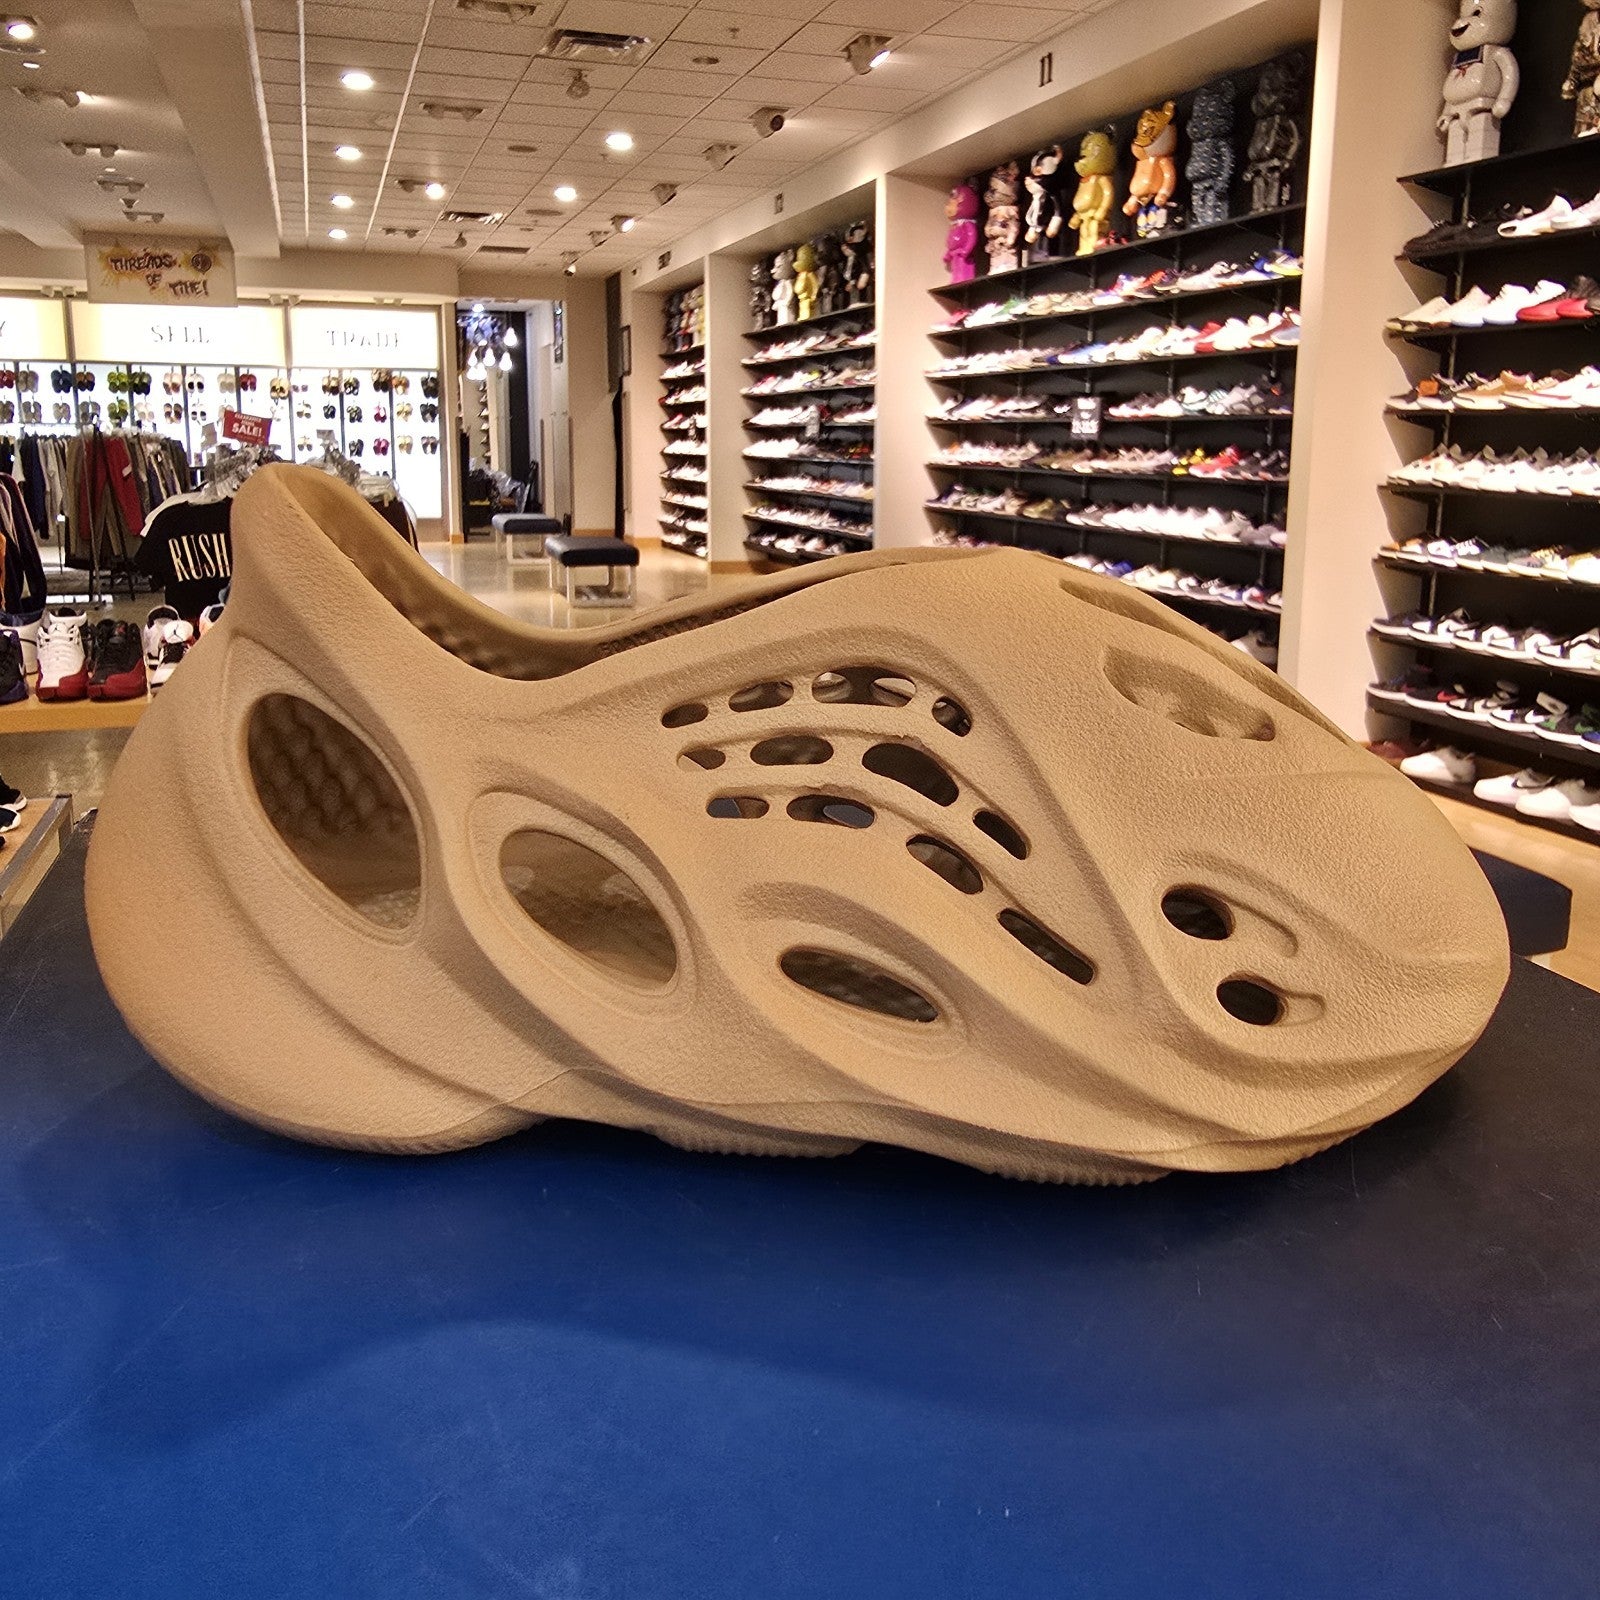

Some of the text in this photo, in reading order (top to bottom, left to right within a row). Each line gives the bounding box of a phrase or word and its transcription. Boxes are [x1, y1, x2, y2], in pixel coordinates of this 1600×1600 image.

[151, 325, 210, 343] SELL
[326, 330, 399, 347] TRADE
[231, 422, 263, 437] SALE!
[168, 533, 231, 582] RUSH
